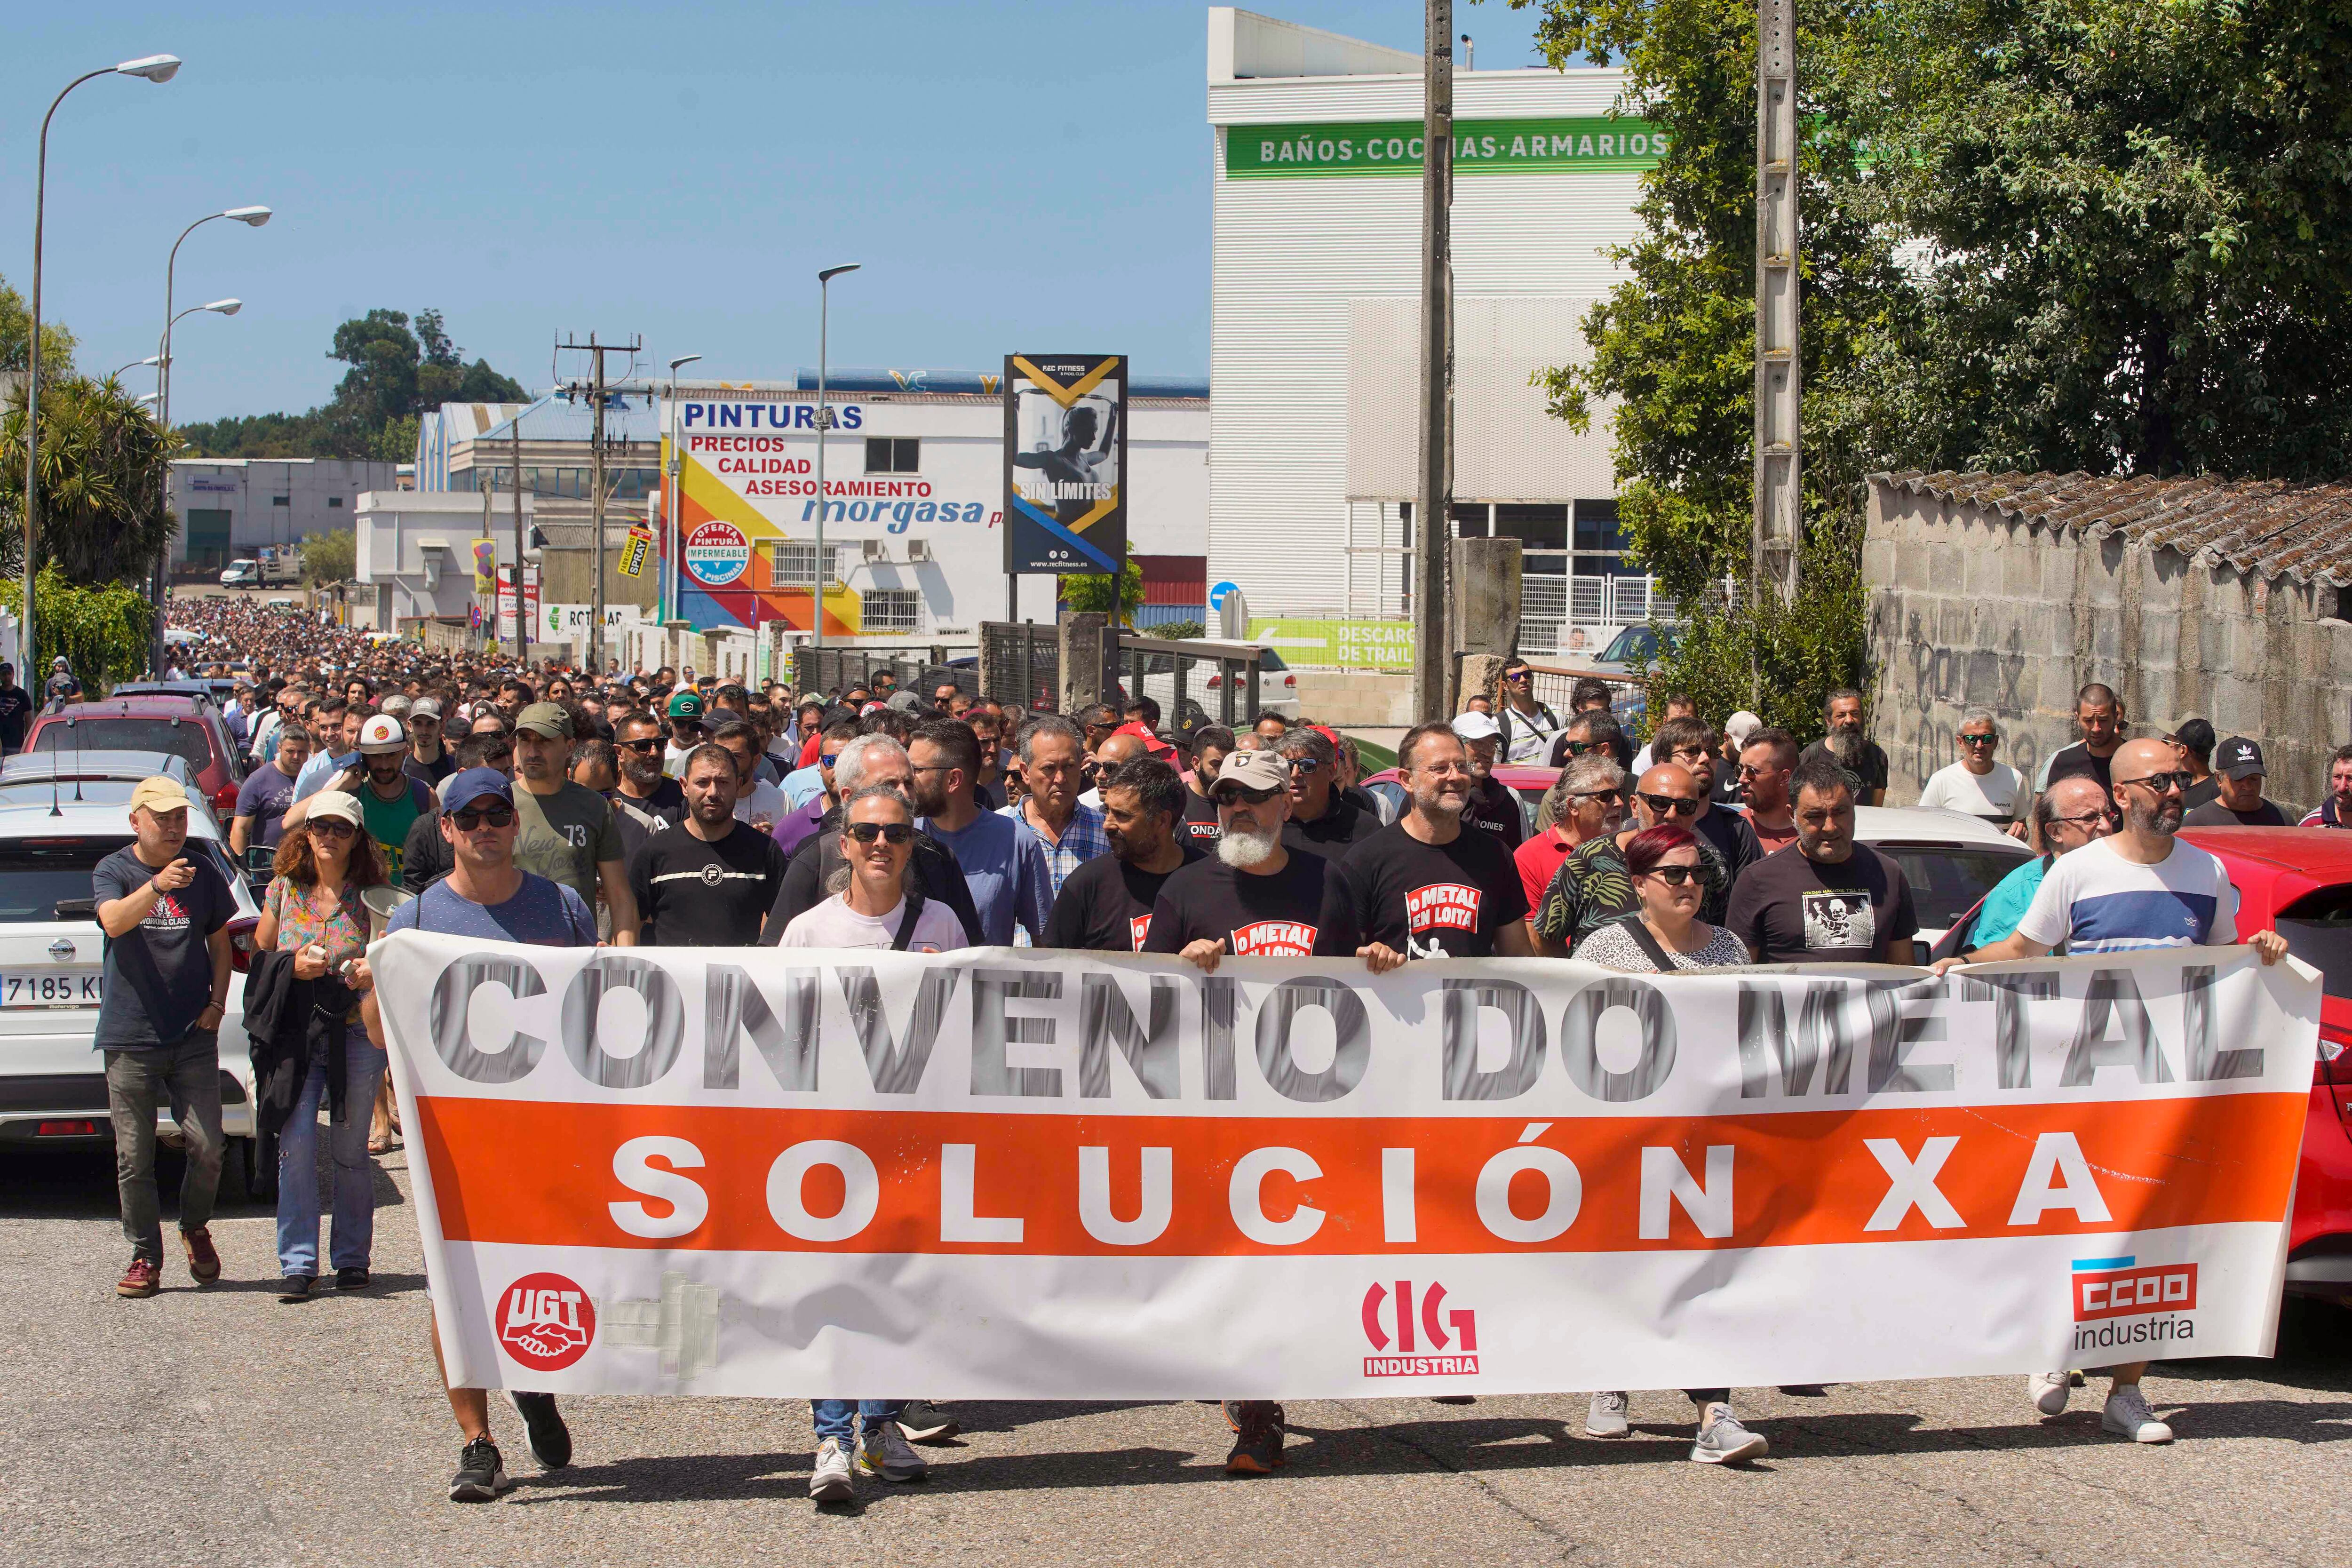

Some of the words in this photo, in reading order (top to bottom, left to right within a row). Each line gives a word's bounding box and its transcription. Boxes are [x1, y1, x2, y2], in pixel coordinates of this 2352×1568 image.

[685, 404, 862, 430] PINTURAS
[691, 437, 785, 453] PRECIOS
[718, 458, 811, 474] CALIDAD
[745, 479, 932, 497] ASESORAMIENTO
[1020, 482, 1046, 500] SIN
[1050, 479, 1112, 500] LÍMITES
[801, 500, 985, 534] morgasa
[697, 524, 738, 539] OFERTA
[620, 537, 636, 572] FABRICAMOS
[629, 540, 646, 574] SPRAY
[687, 549, 747, 557] IMPERMEABLE
[692, 563, 704, 575] DE
[705, 562, 743, 581] PISCINAS
[1339, 645, 1360, 661] DE
[271, 788, 290, 807] JACK
[564, 824, 587, 847] 73
[1410, 898, 1420, 912] O
[1422, 886, 1477, 910] METAL
[140, 917, 168, 926] WORKING
[1413, 909, 1430, 928] EN
[1435, 906, 1472, 927] LOITA
[1238, 937, 1248, 952] O
[1249, 924, 1311, 949] METAL
[8, 977, 72, 1001] 7185
[430, 952, 1371, 1102] CONVENIO
[1441, 978, 1677, 1102] DO
[1738, 965, 2264, 1098] METAL
[608, 1122, 1735, 1245] SOLUCIÓN
[1863, 1132, 2113, 1232] XA
[2082, 1274, 2189, 1312] CCOO
[508, 1288, 584, 1328] UGT
[1361, 1280, 1477, 1352] CIG
[2074, 1314, 2194, 1350] industria
[1367, 1357, 1477, 1375] INDUSTRIA
